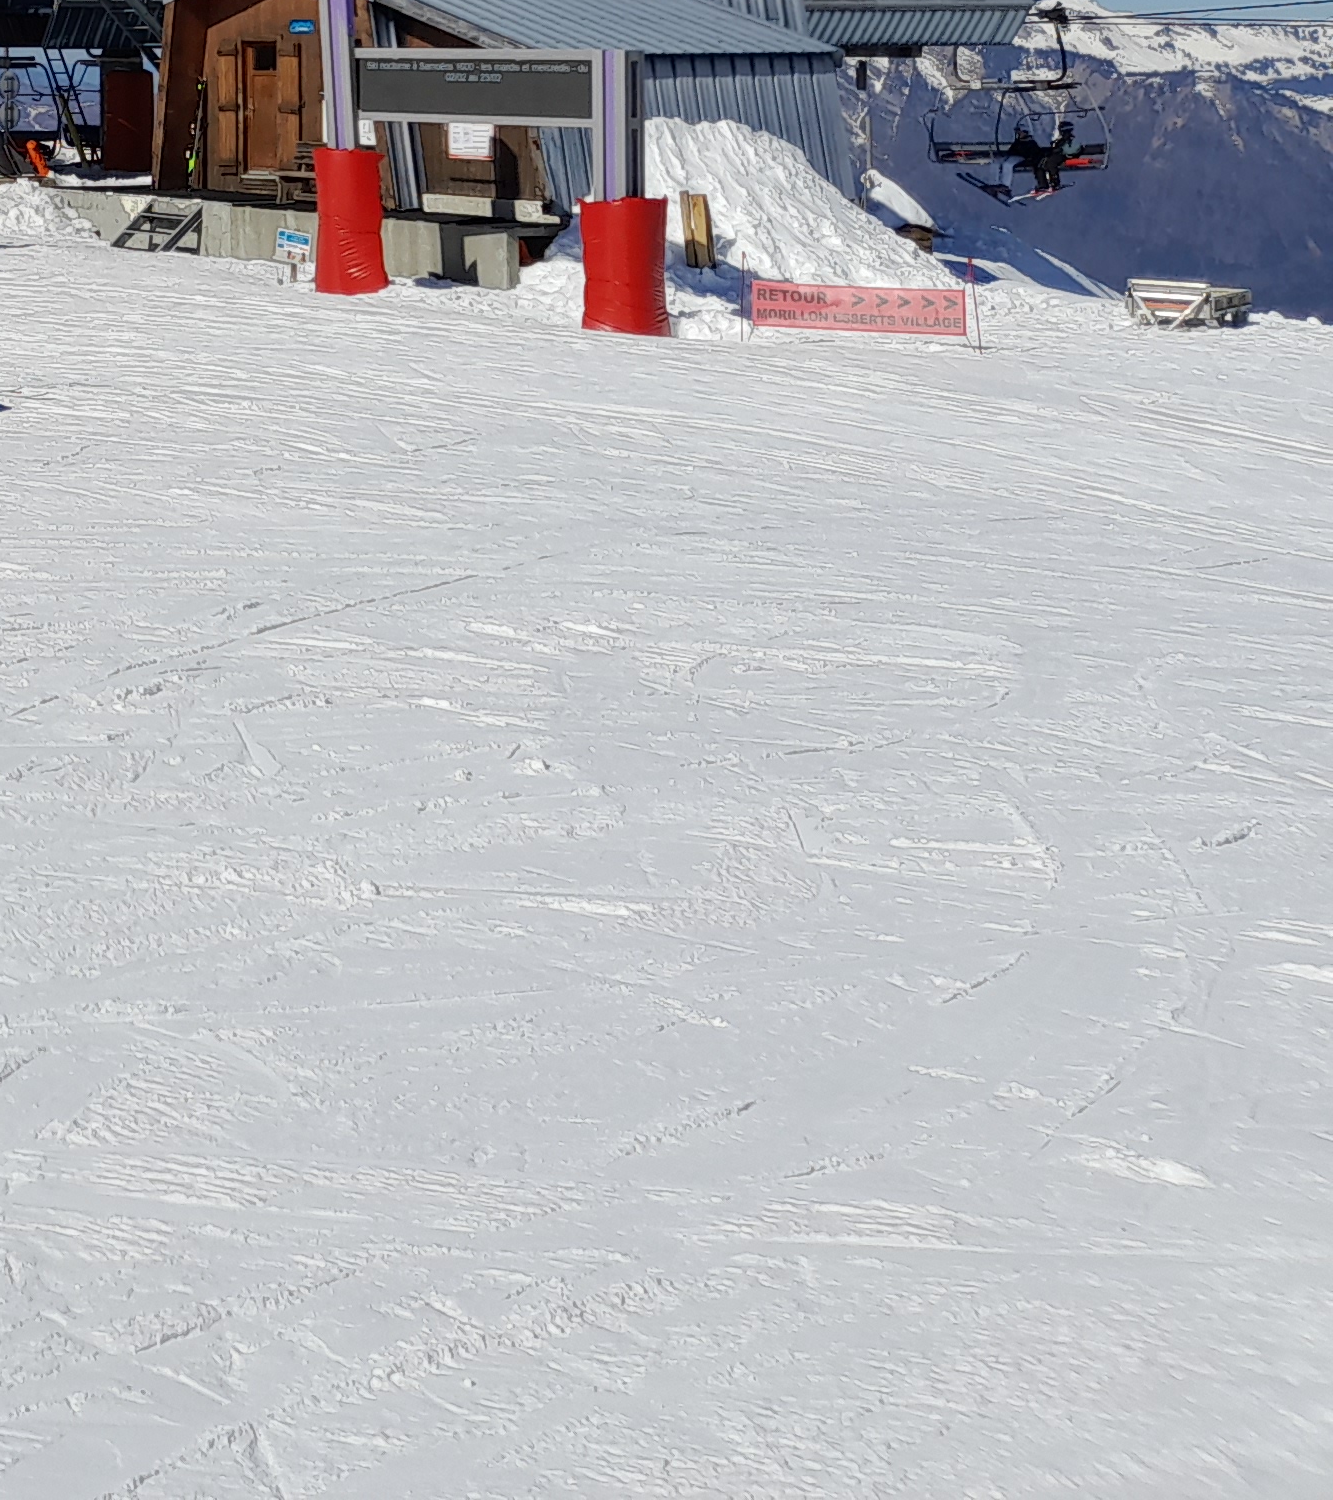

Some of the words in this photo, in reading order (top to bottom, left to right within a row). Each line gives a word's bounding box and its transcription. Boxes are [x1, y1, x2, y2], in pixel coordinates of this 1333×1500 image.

[756, 287, 828, 305] RETOUR
[756, 307, 829, 322] MORILLON
[833, 312, 896, 326] ESSERTS
[900, 316, 962, 329] VILLAGE
